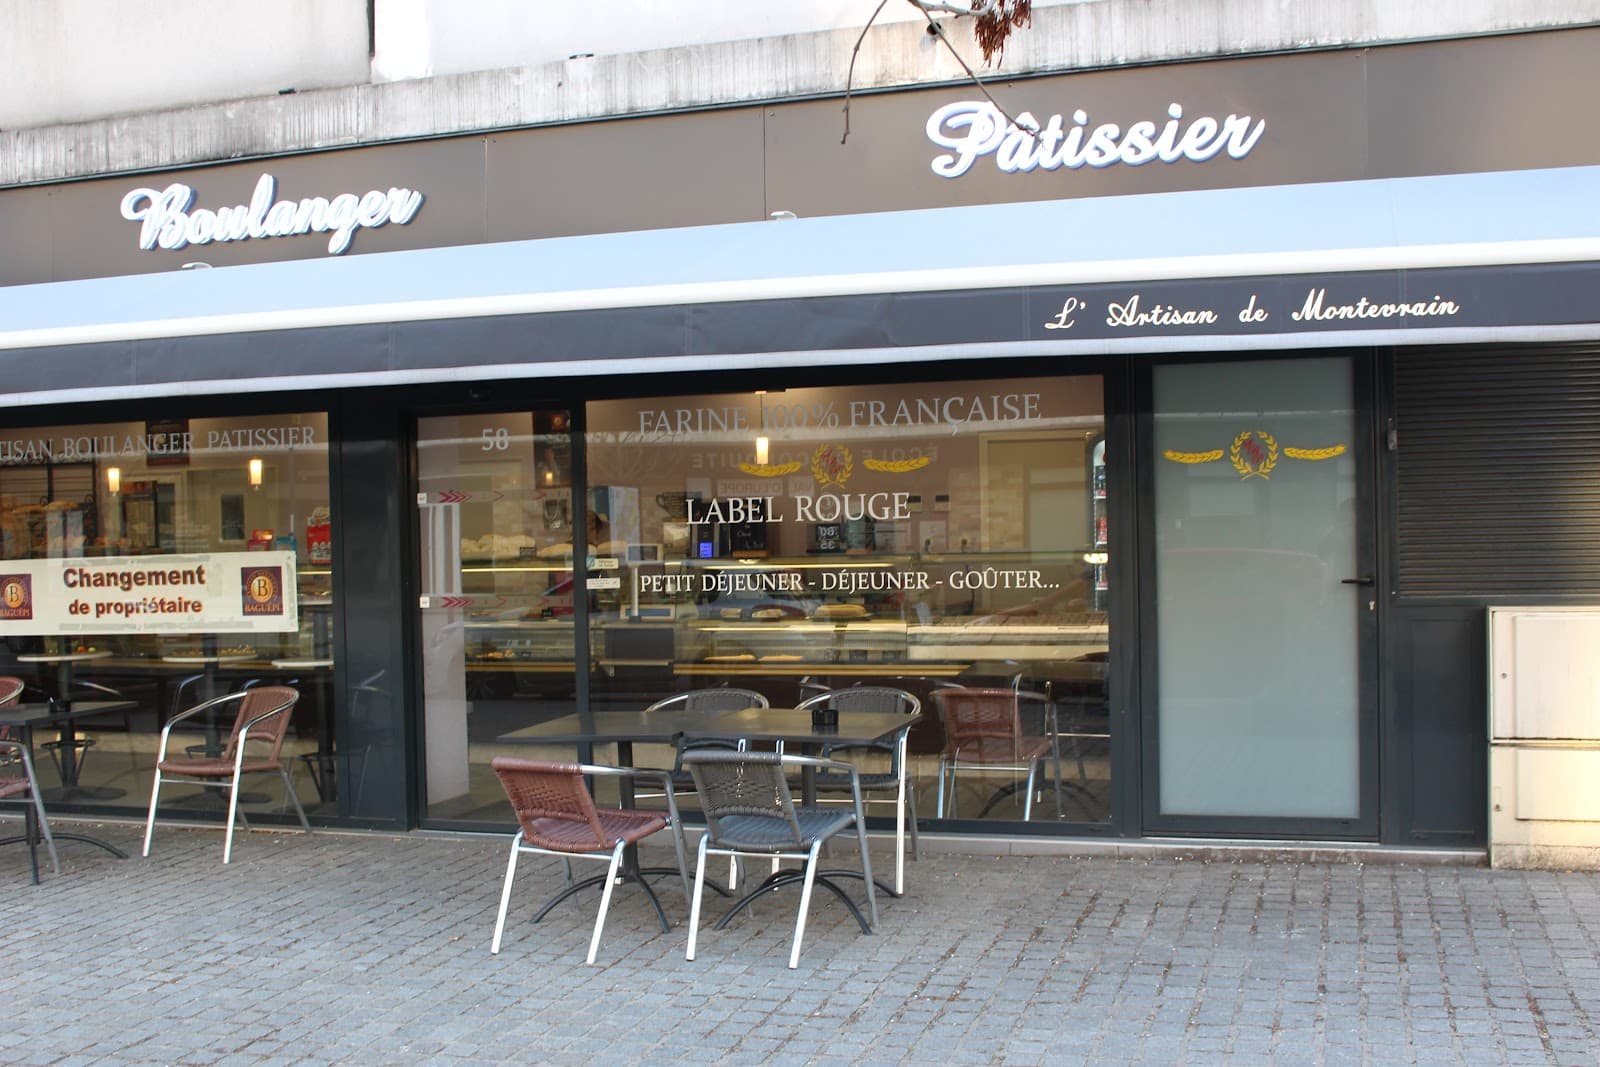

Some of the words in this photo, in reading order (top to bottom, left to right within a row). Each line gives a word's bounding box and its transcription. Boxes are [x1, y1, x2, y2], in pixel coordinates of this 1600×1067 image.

[926, 100, 1266, 178] Pâtissier
[120, 173, 425, 254] Boulanger
[1044, 297, 1086, 331] L'
[1106, 295, 1218, 328] Artisan
[1238, 295, 1269, 324] de
[1291, 288, 1460, 323] Montevrain
[638, 405, 749, 436] FARINE
[760, 401, 839, 431] 100%
[849, 393, 1042, 436] FRANÇAISE
[63, 430, 195, 459] BOULANGER
[207, 426, 315, 450] PATISSIER
[481, 428, 509, 451] 58
[686, 495, 783, 525] LABEL
[794, 491, 911, 523] ROUGE
[63, 564, 206, 593] Changement
[640, 572, 696, 593] PETIT
[701, 567, 803, 597] DÉJEUNER
[821, 567, 930, 596] DÉJEUNER
[68, 598, 89, 615] de
[95, 595, 203, 618] propriétaire
